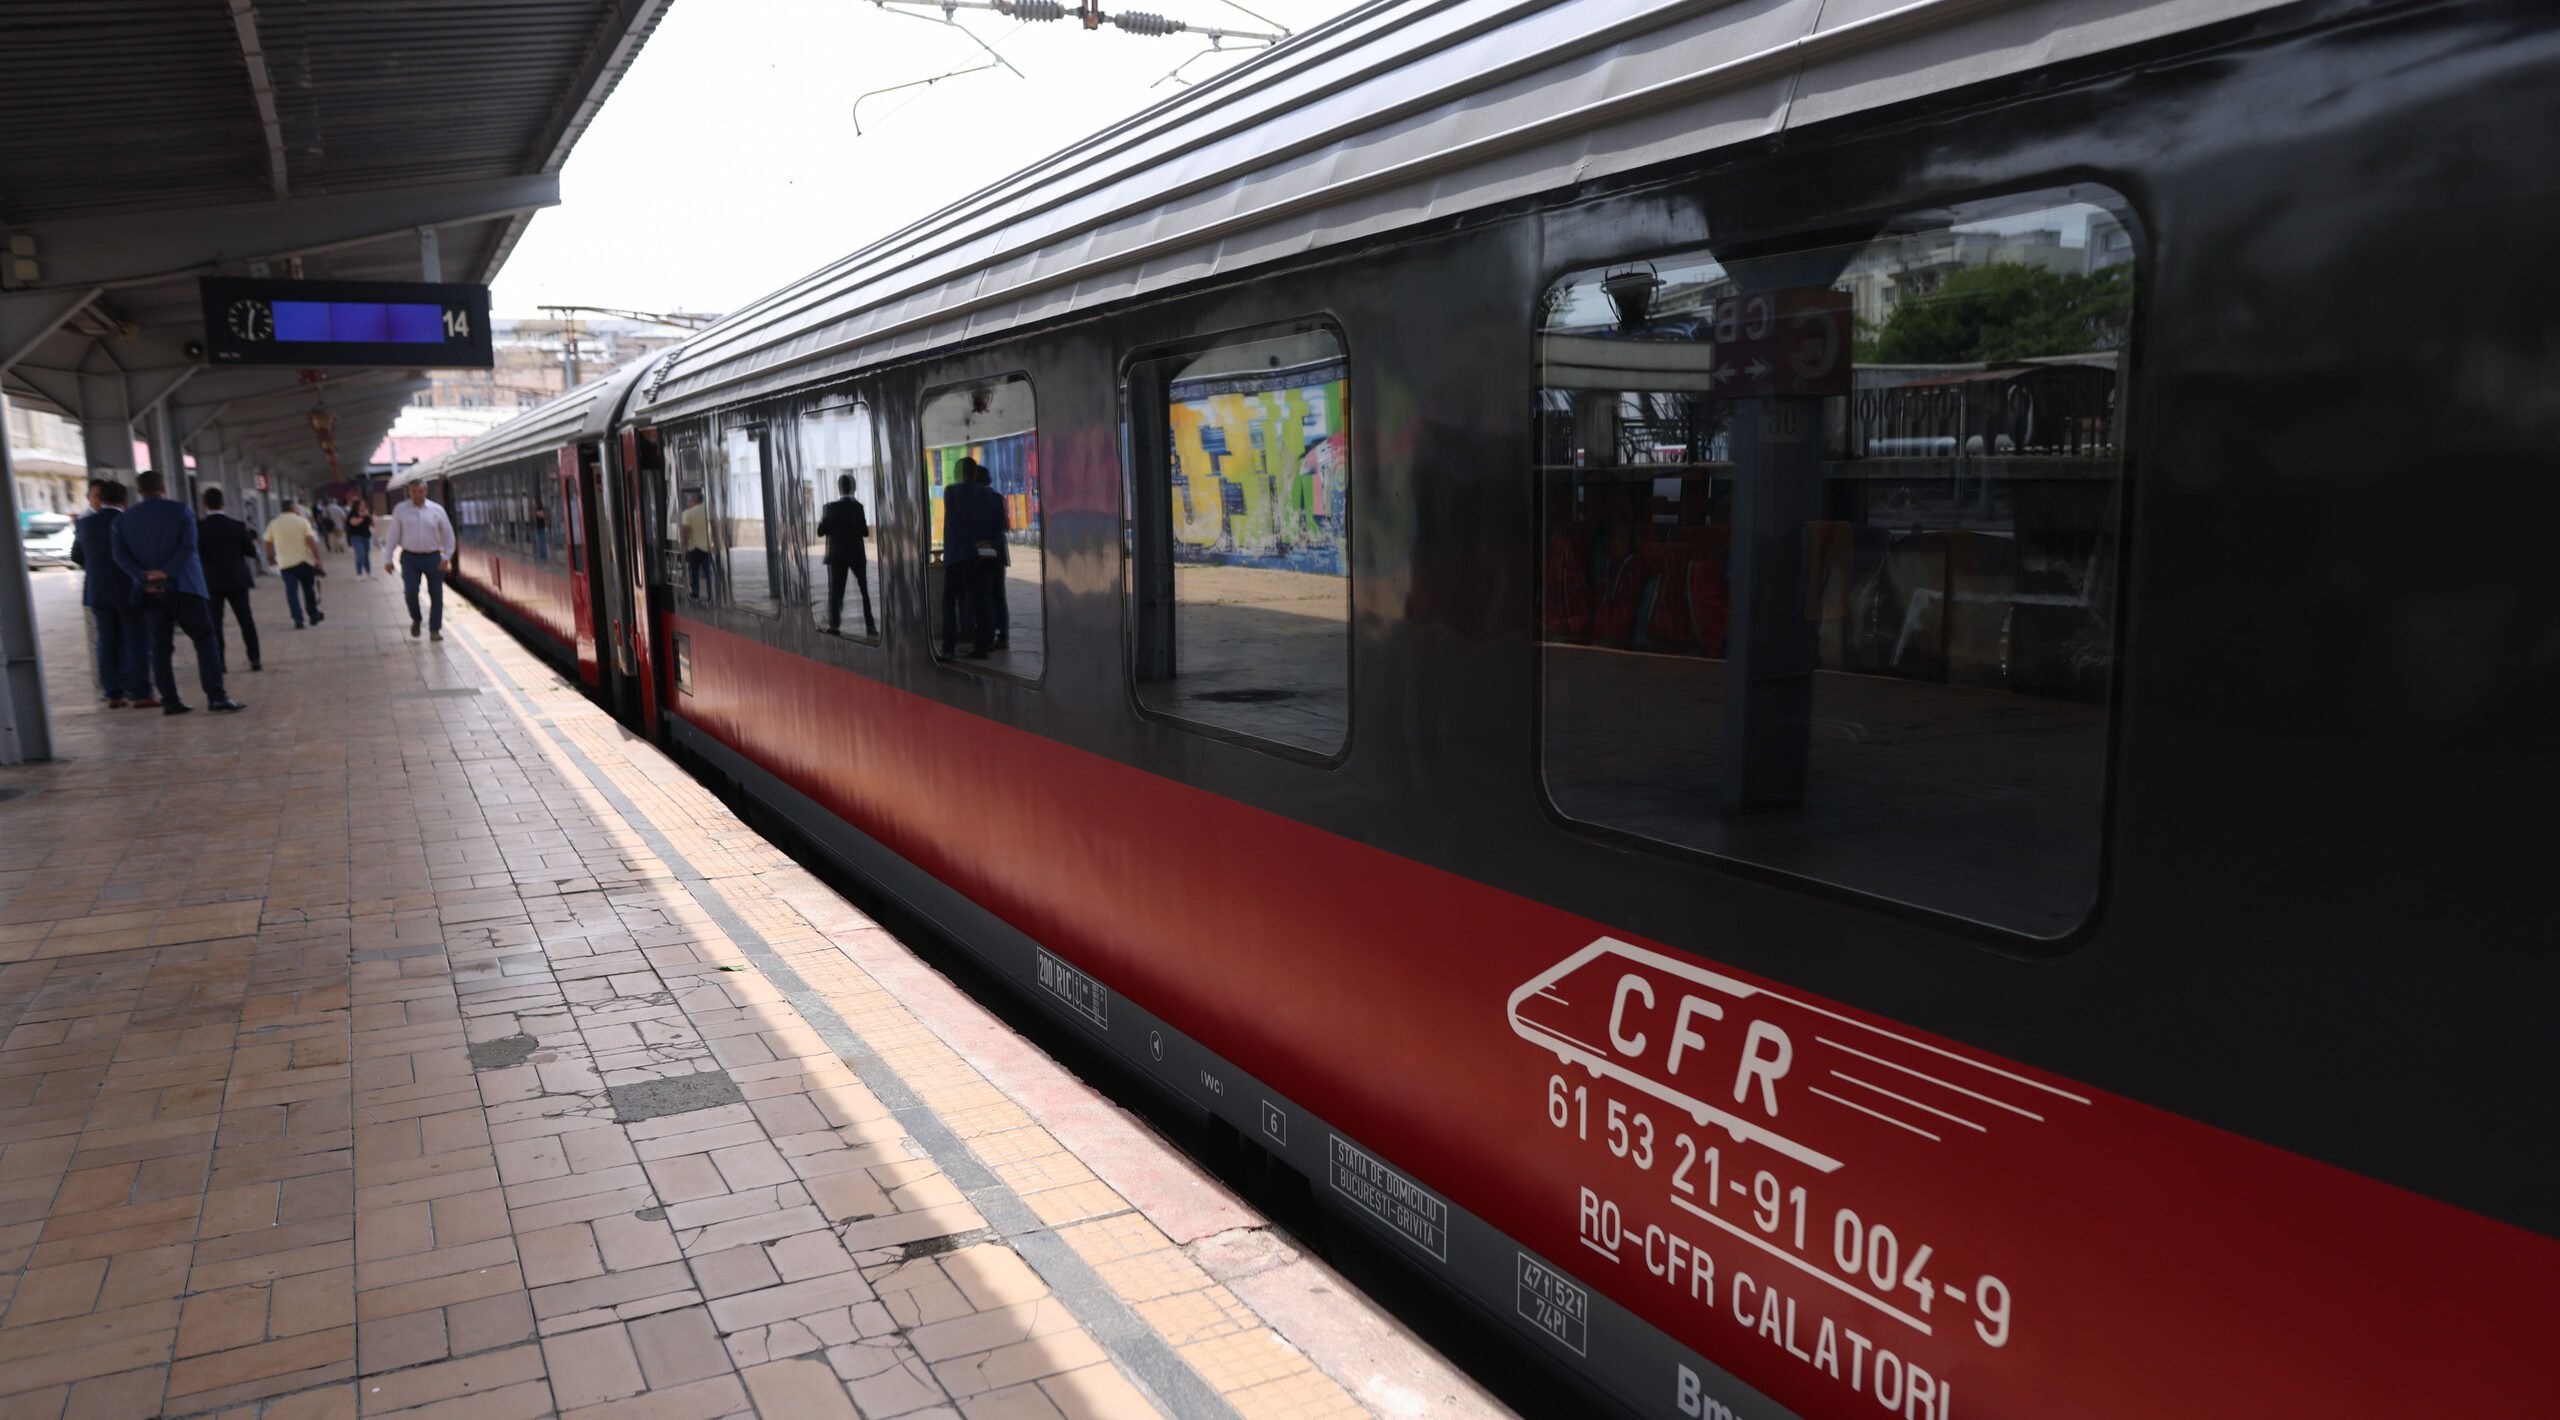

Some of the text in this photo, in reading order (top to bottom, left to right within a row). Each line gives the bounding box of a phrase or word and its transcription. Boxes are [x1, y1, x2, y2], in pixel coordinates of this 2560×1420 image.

[442, 310, 470, 337] 14
[1040, 954, 1072, 1000] 200 RIC
[1608, 973, 1793, 1117] CFR
[1271, 1113, 1278, 1133] 6
[1370, 1163, 1383, 1188] DE
[1386, 1173, 1437, 1221] DOMICILIU
[1548, 1074, 2011, 1347] 61 53 21-91 004-9
[1580, 1185, 1950, 1420] RO-CFR CALATORI
